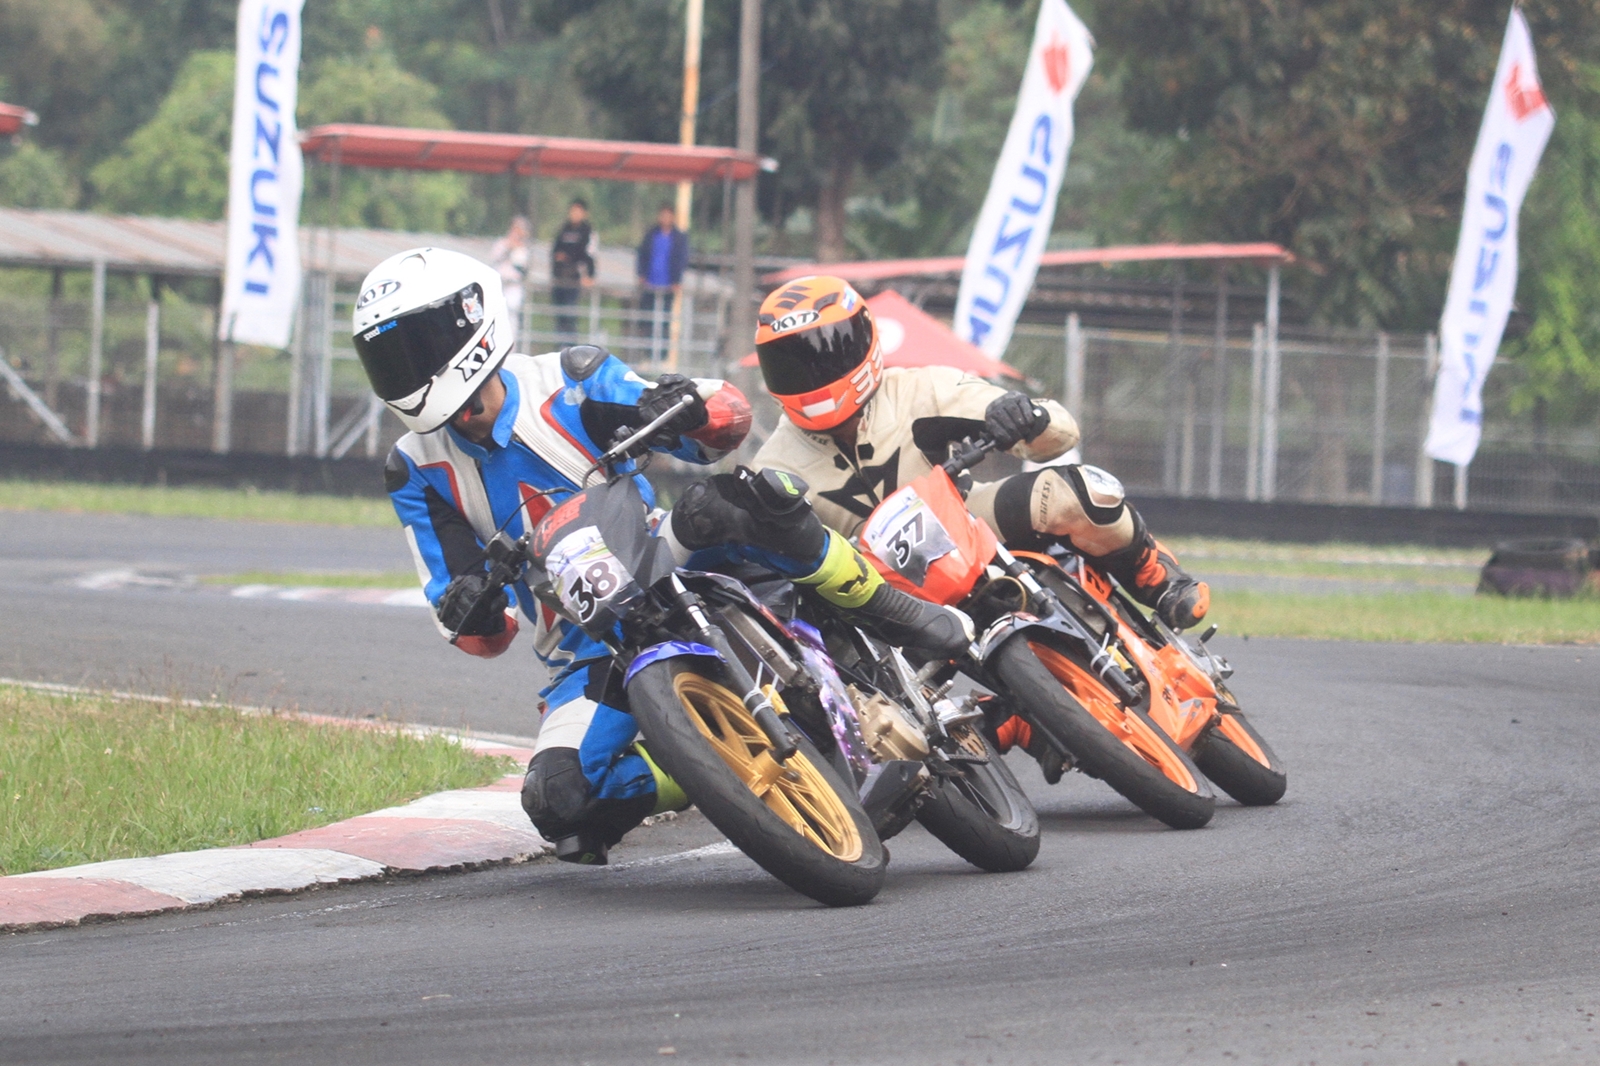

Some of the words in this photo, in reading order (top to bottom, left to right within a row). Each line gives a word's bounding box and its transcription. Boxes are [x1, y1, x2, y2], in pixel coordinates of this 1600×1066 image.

[244, 4, 290, 295] SUZUKI
[358, 281, 394, 309] KYT
[775, 311, 813, 331] KYT
[455, 318, 496, 382] KYT
[885, 510, 926, 569] 37
[568, 560, 620, 623] 38
